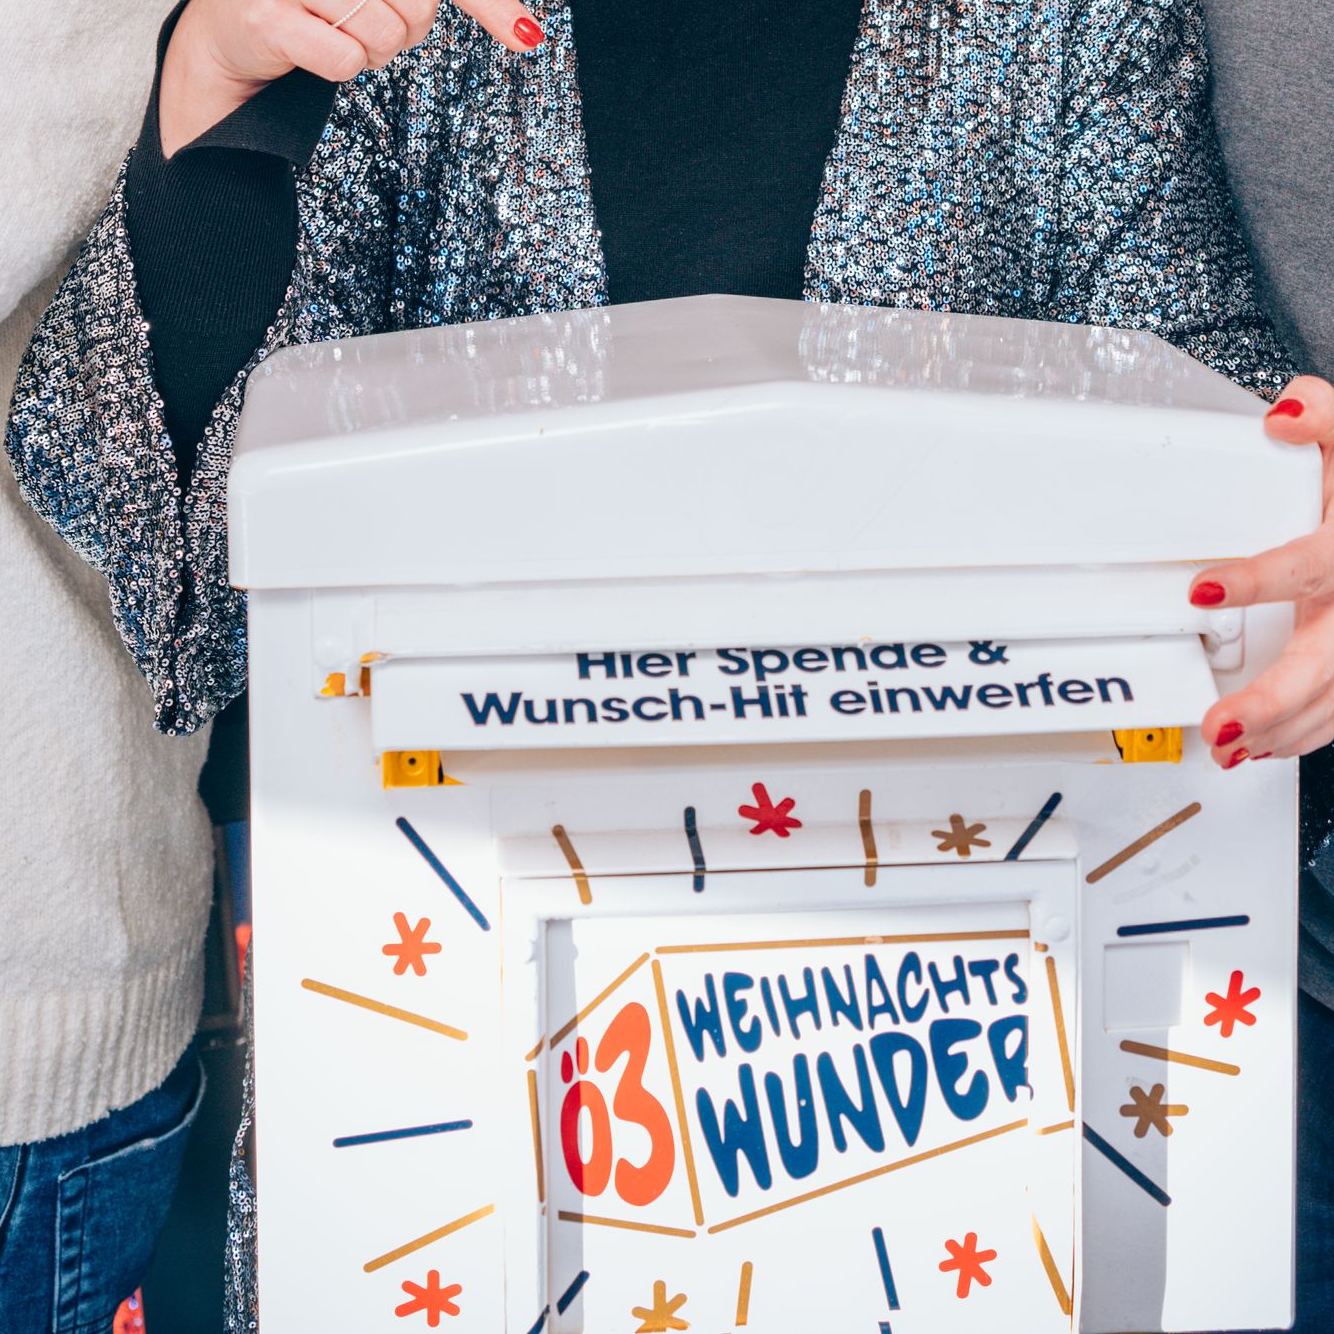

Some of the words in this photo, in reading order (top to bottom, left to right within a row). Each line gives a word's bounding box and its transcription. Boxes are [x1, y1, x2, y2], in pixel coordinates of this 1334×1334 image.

[460, 684, 809, 726] Wunsch-Hit
[828, 672, 1136, 715] einwerfen
[574, 649, 698, 681] Hier
[716, 642, 949, 683] Spende
[965, 640, 1011, 666] &
[675, 950, 1029, 1063] WEIHNACHTS
[559, 1001, 676, 1207] Ö3
[695, 1014, 1034, 1198] WUNDER
